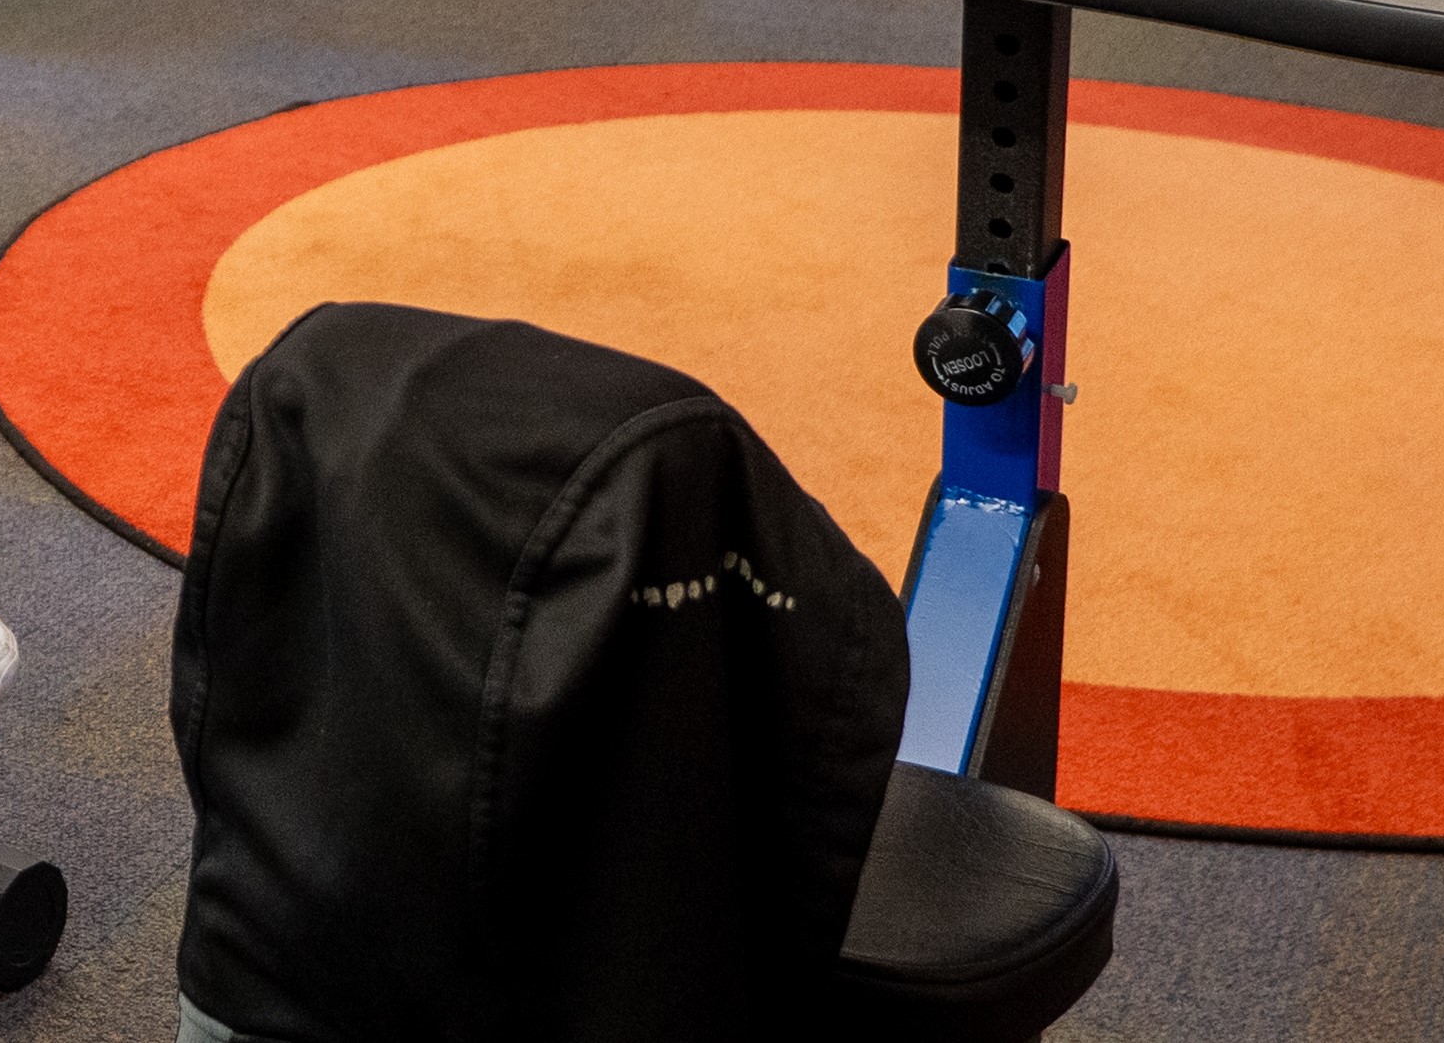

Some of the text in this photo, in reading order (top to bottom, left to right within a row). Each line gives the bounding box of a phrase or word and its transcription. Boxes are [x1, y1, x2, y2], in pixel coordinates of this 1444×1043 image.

[941, 351, 991, 376] LOOSEN
[943, 367, 1006, 396] TO ADJUST
